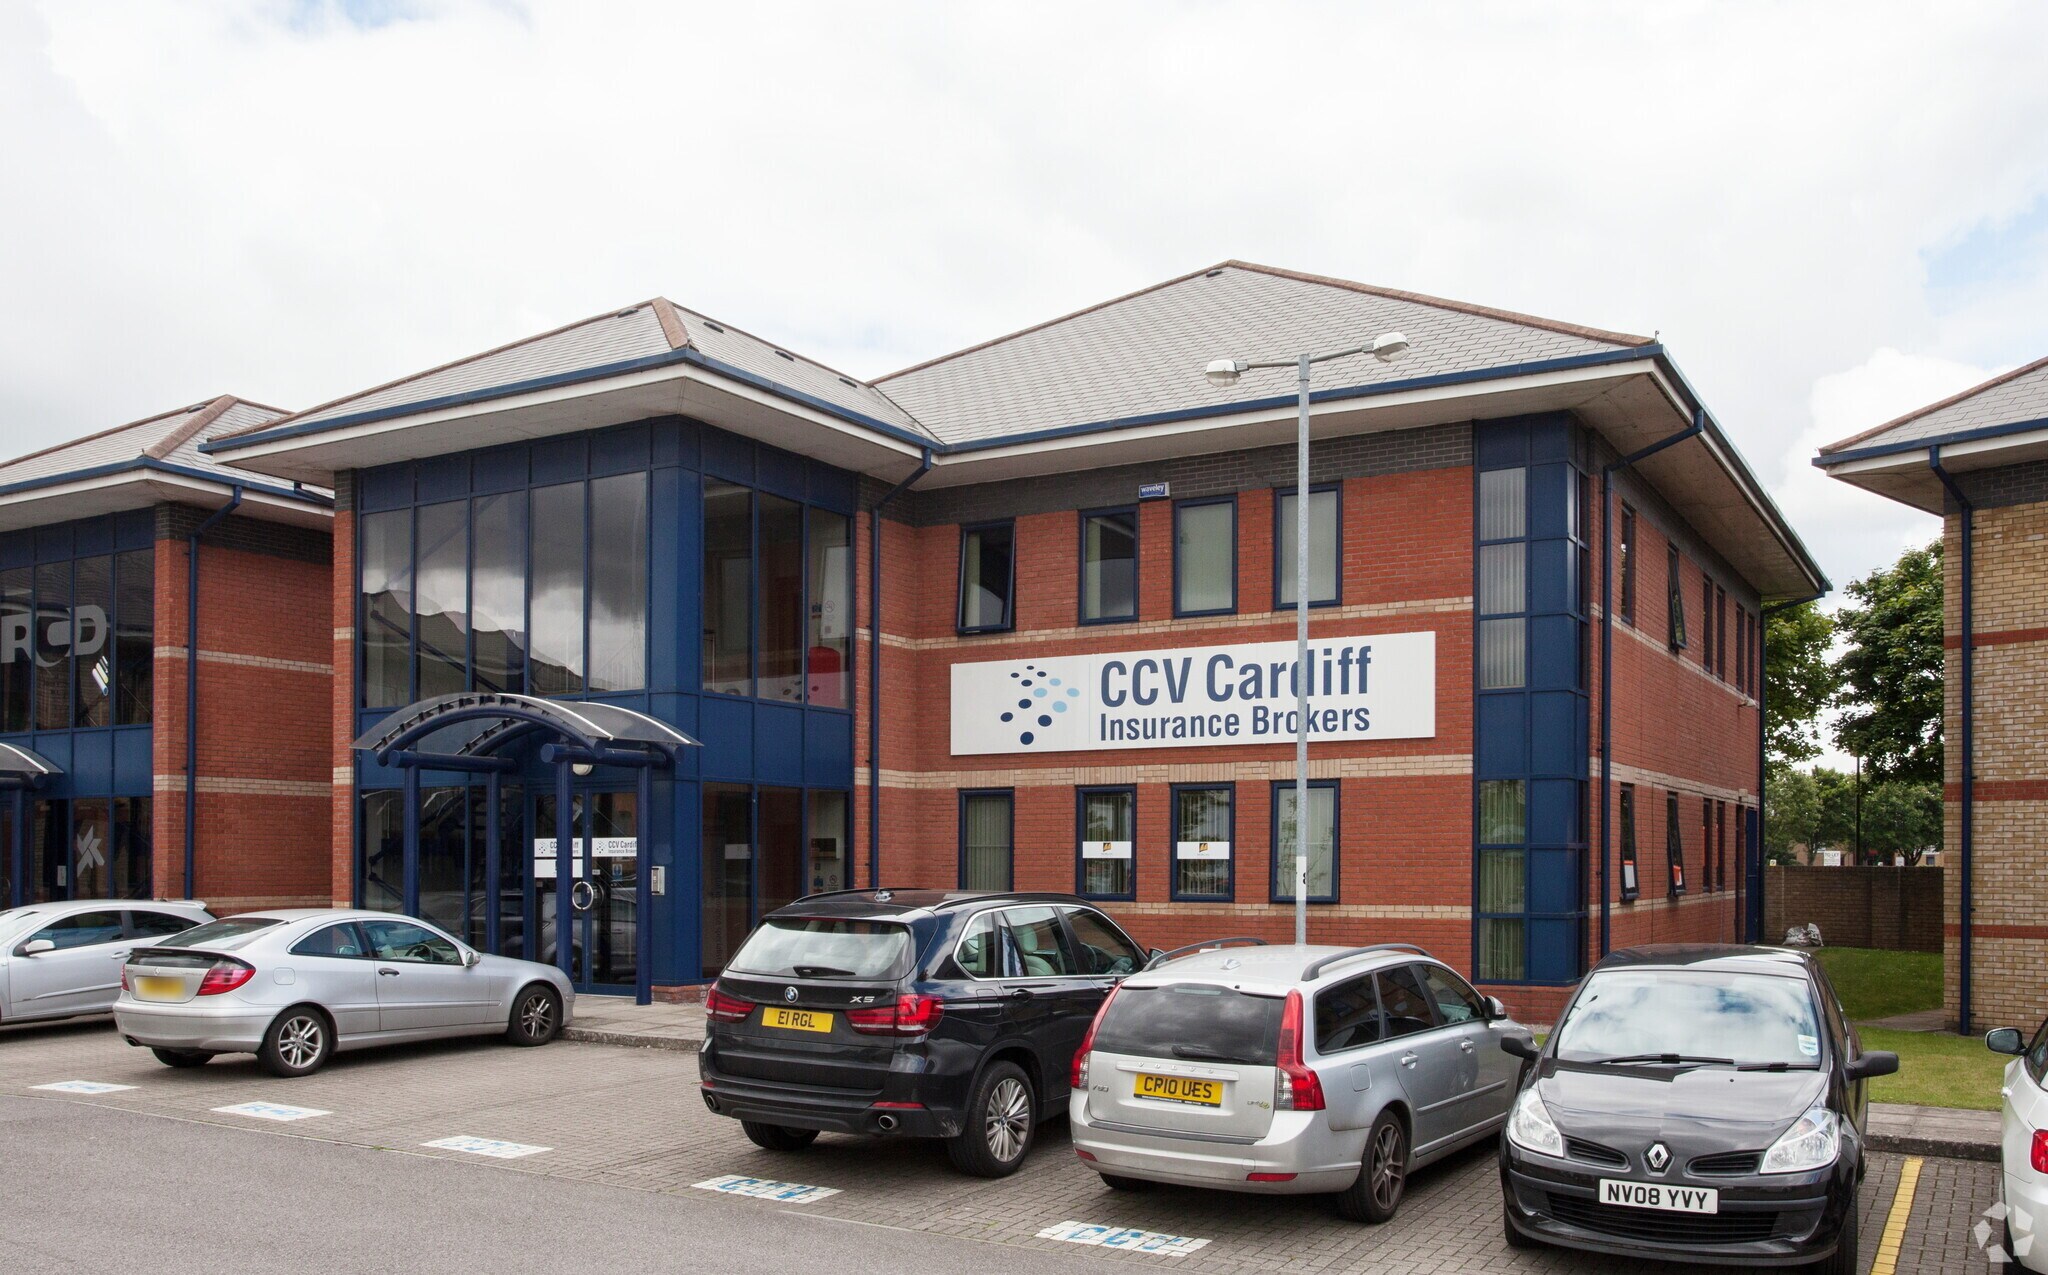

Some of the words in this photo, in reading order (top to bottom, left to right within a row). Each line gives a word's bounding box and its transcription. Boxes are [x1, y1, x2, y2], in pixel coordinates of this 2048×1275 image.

[1101, 657, 1192, 708] CCV
[1206, 645, 1372, 703] Cardiff
[1100, 712, 1240, 741] Insurance
[1252, 703, 1370, 736] Brokers
[849, 996, 875, 1004] X5
[791, 1013, 816, 1028] RGL
[1137, 1061, 1214, 1075] VOLVO
[1144, 1076, 1178, 1096] CP10
[1181, 1080, 1213, 1099] UES
[1607, 1183, 1660, 1206] NV08
[1667, 1189, 1708, 1210] YVY
